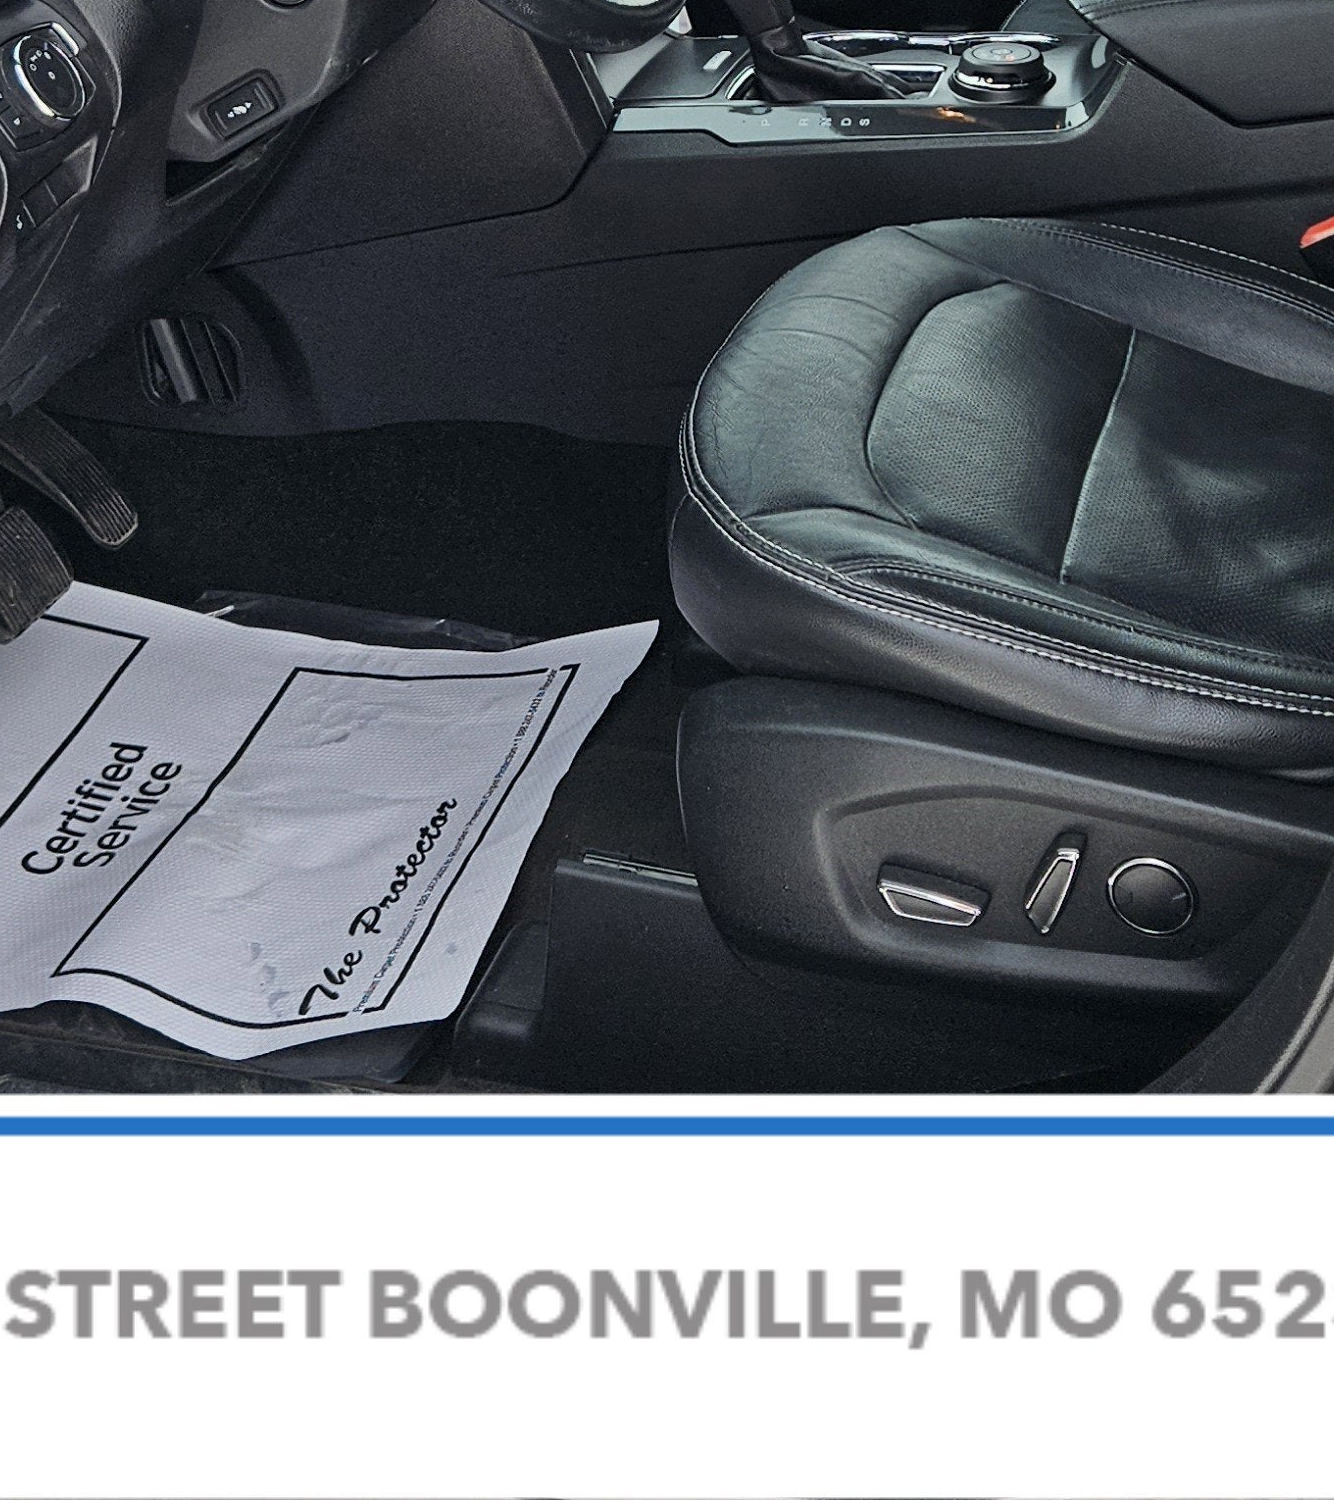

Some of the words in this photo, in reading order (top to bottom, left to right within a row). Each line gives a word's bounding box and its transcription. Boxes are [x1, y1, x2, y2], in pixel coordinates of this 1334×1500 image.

[840, 117, 852, 127] D
[859, 117, 870, 127] S
[21, 742, 148, 874] Certified
[73, 762, 182, 867] Service
[298, 949, 363, 1015] The
[348, 798, 457, 937] Protector
